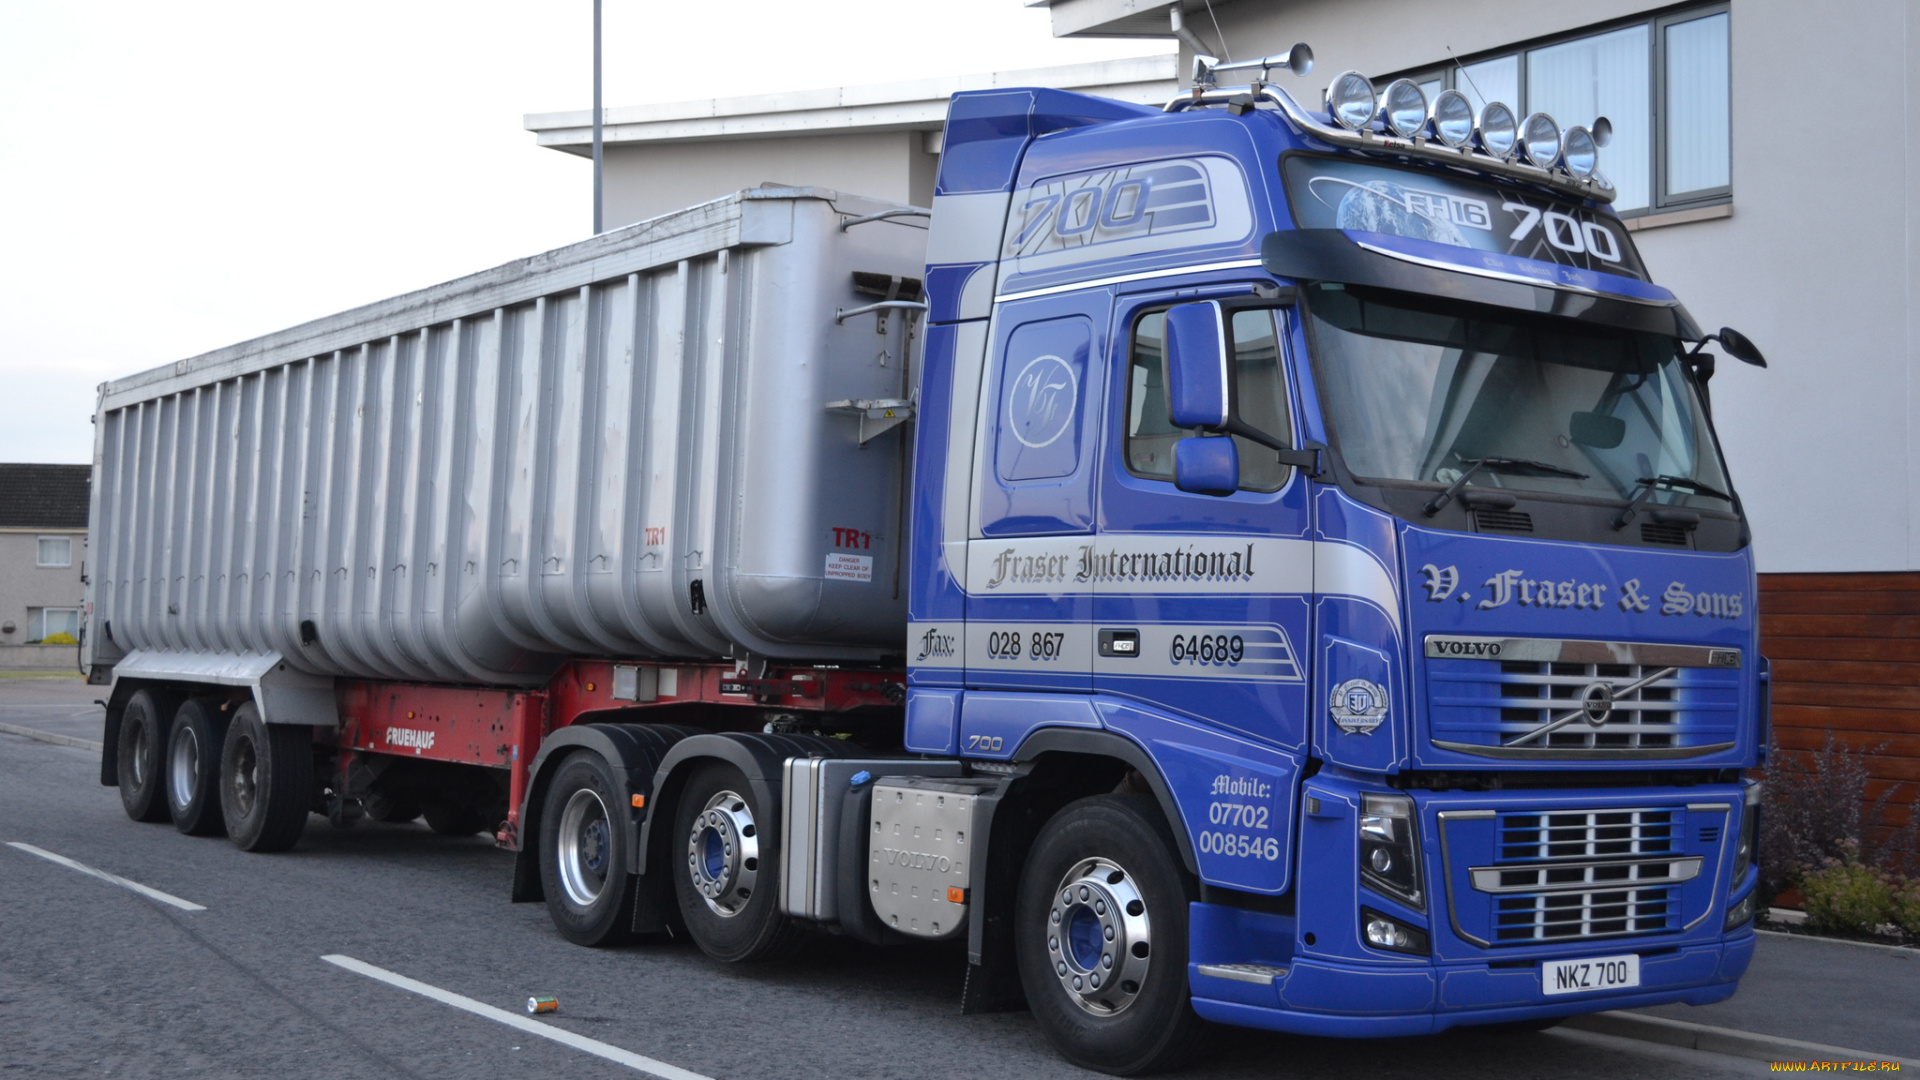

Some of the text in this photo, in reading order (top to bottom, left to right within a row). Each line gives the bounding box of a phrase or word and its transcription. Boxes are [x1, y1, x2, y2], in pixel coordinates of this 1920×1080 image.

[1009, 178, 1152, 246] 700
[1404, 192, 1621, 263] FH16 700
[645, 526, 665, 547] TR1
[832, 526, 871, 550] TR1
[986, 543, 1256, 589] Fraser International
[1475, 568, 1607, 611] Fraser
[1617, 577, 1650, 613] &
[1660, 580, 1743, 619] Sons
[917, 627, 1244, 664] Fax: 028 867 64689
[1434, 640, 1501, 656] VOLVO
[386, 726, 435, 750] FRUEHAUF
[968, 734, 1003, 752] 700
[1209, 774, 1271, 799] Mobile:
[1209, 801, 1269, 829] 07702
[1199, 830, 1279, 861] 008546
[883, 847, 951, 873] VOLVO
[1556, 960, 1627, 990] NKZ 700
